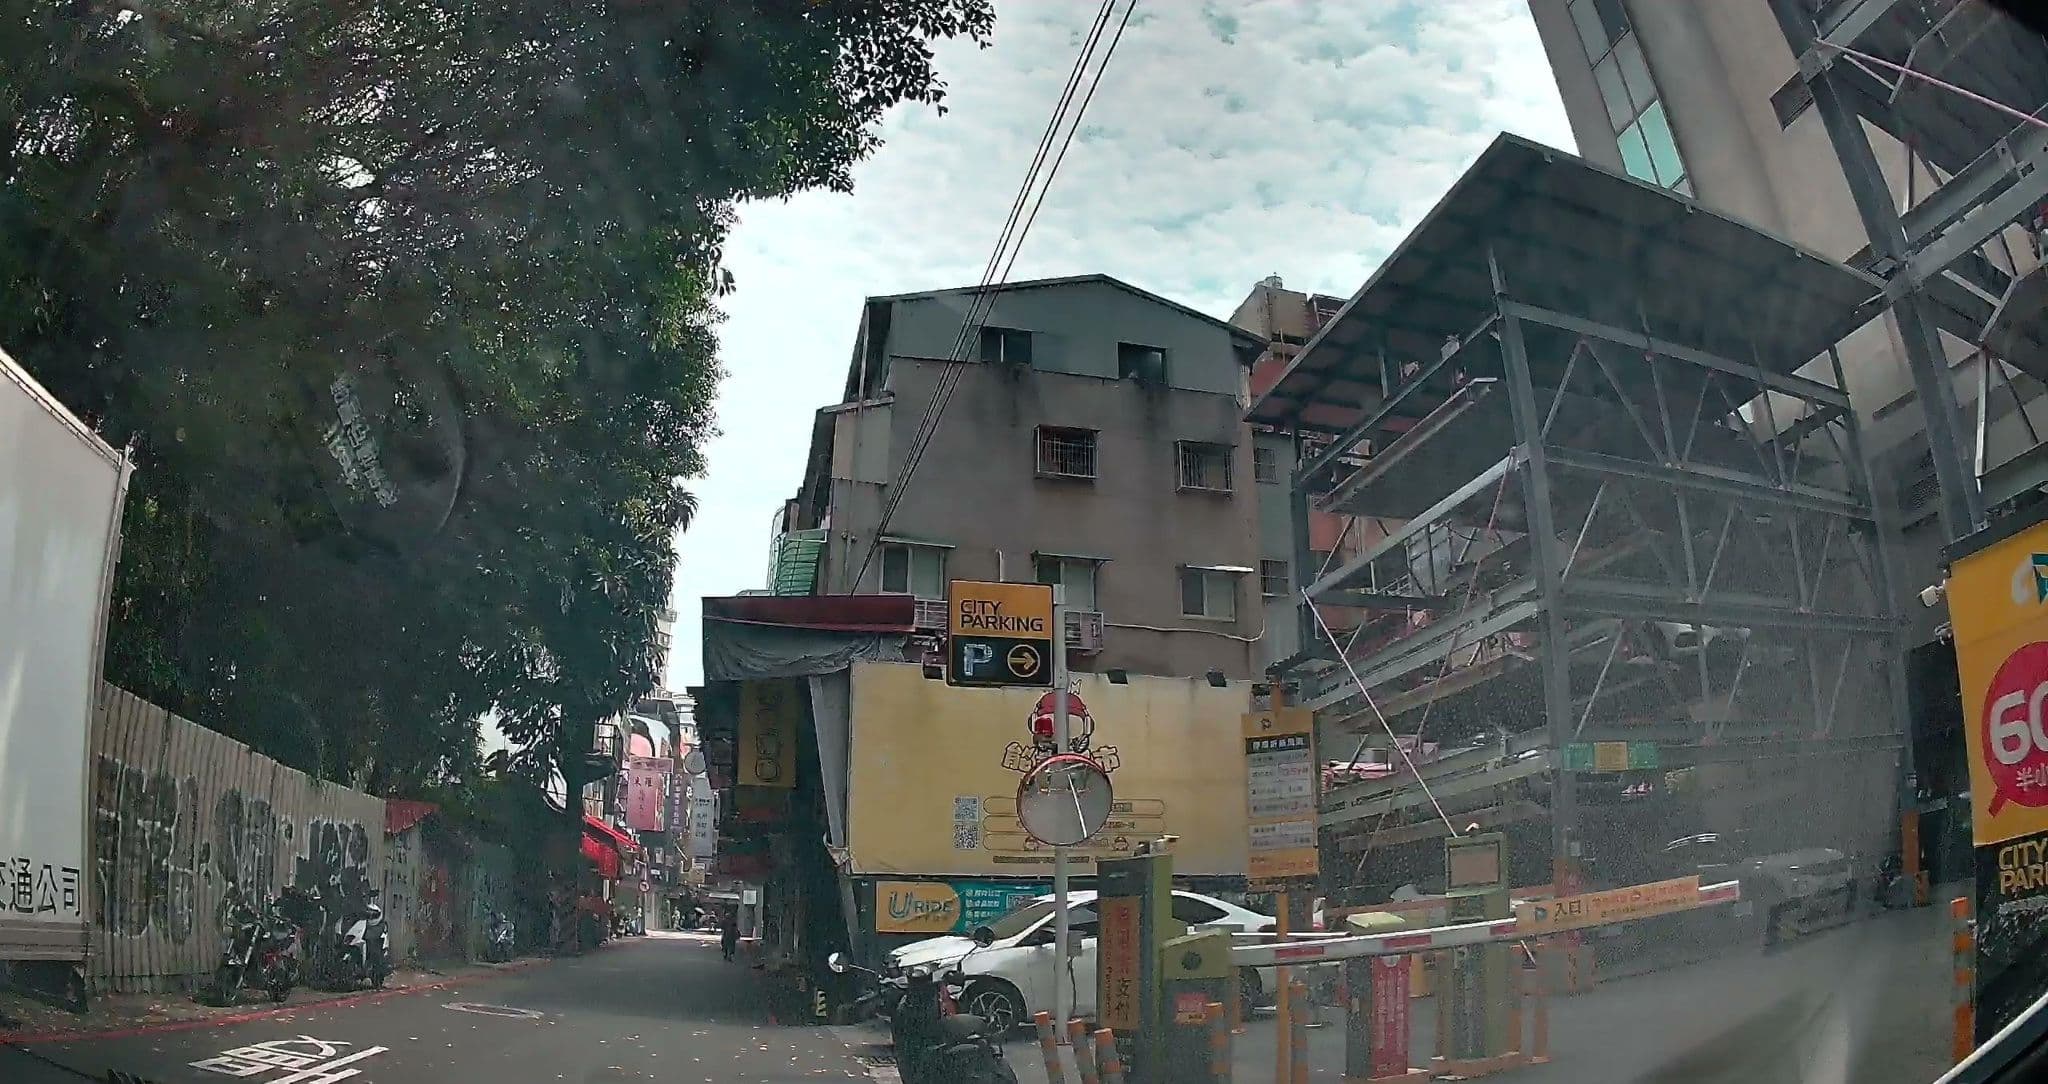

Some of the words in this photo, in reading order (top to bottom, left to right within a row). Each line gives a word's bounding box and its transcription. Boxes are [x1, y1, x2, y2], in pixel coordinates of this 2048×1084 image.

[960, 599, 1002, 615] CITY
[960, 614, 1044, 632] PARKING
[963, 643, 993, 676] P
[1999, 838, 2048, 870] CITY
[2000, 862, 2048, 895] PAR
[1554, 900, 1582, 923] 入口
